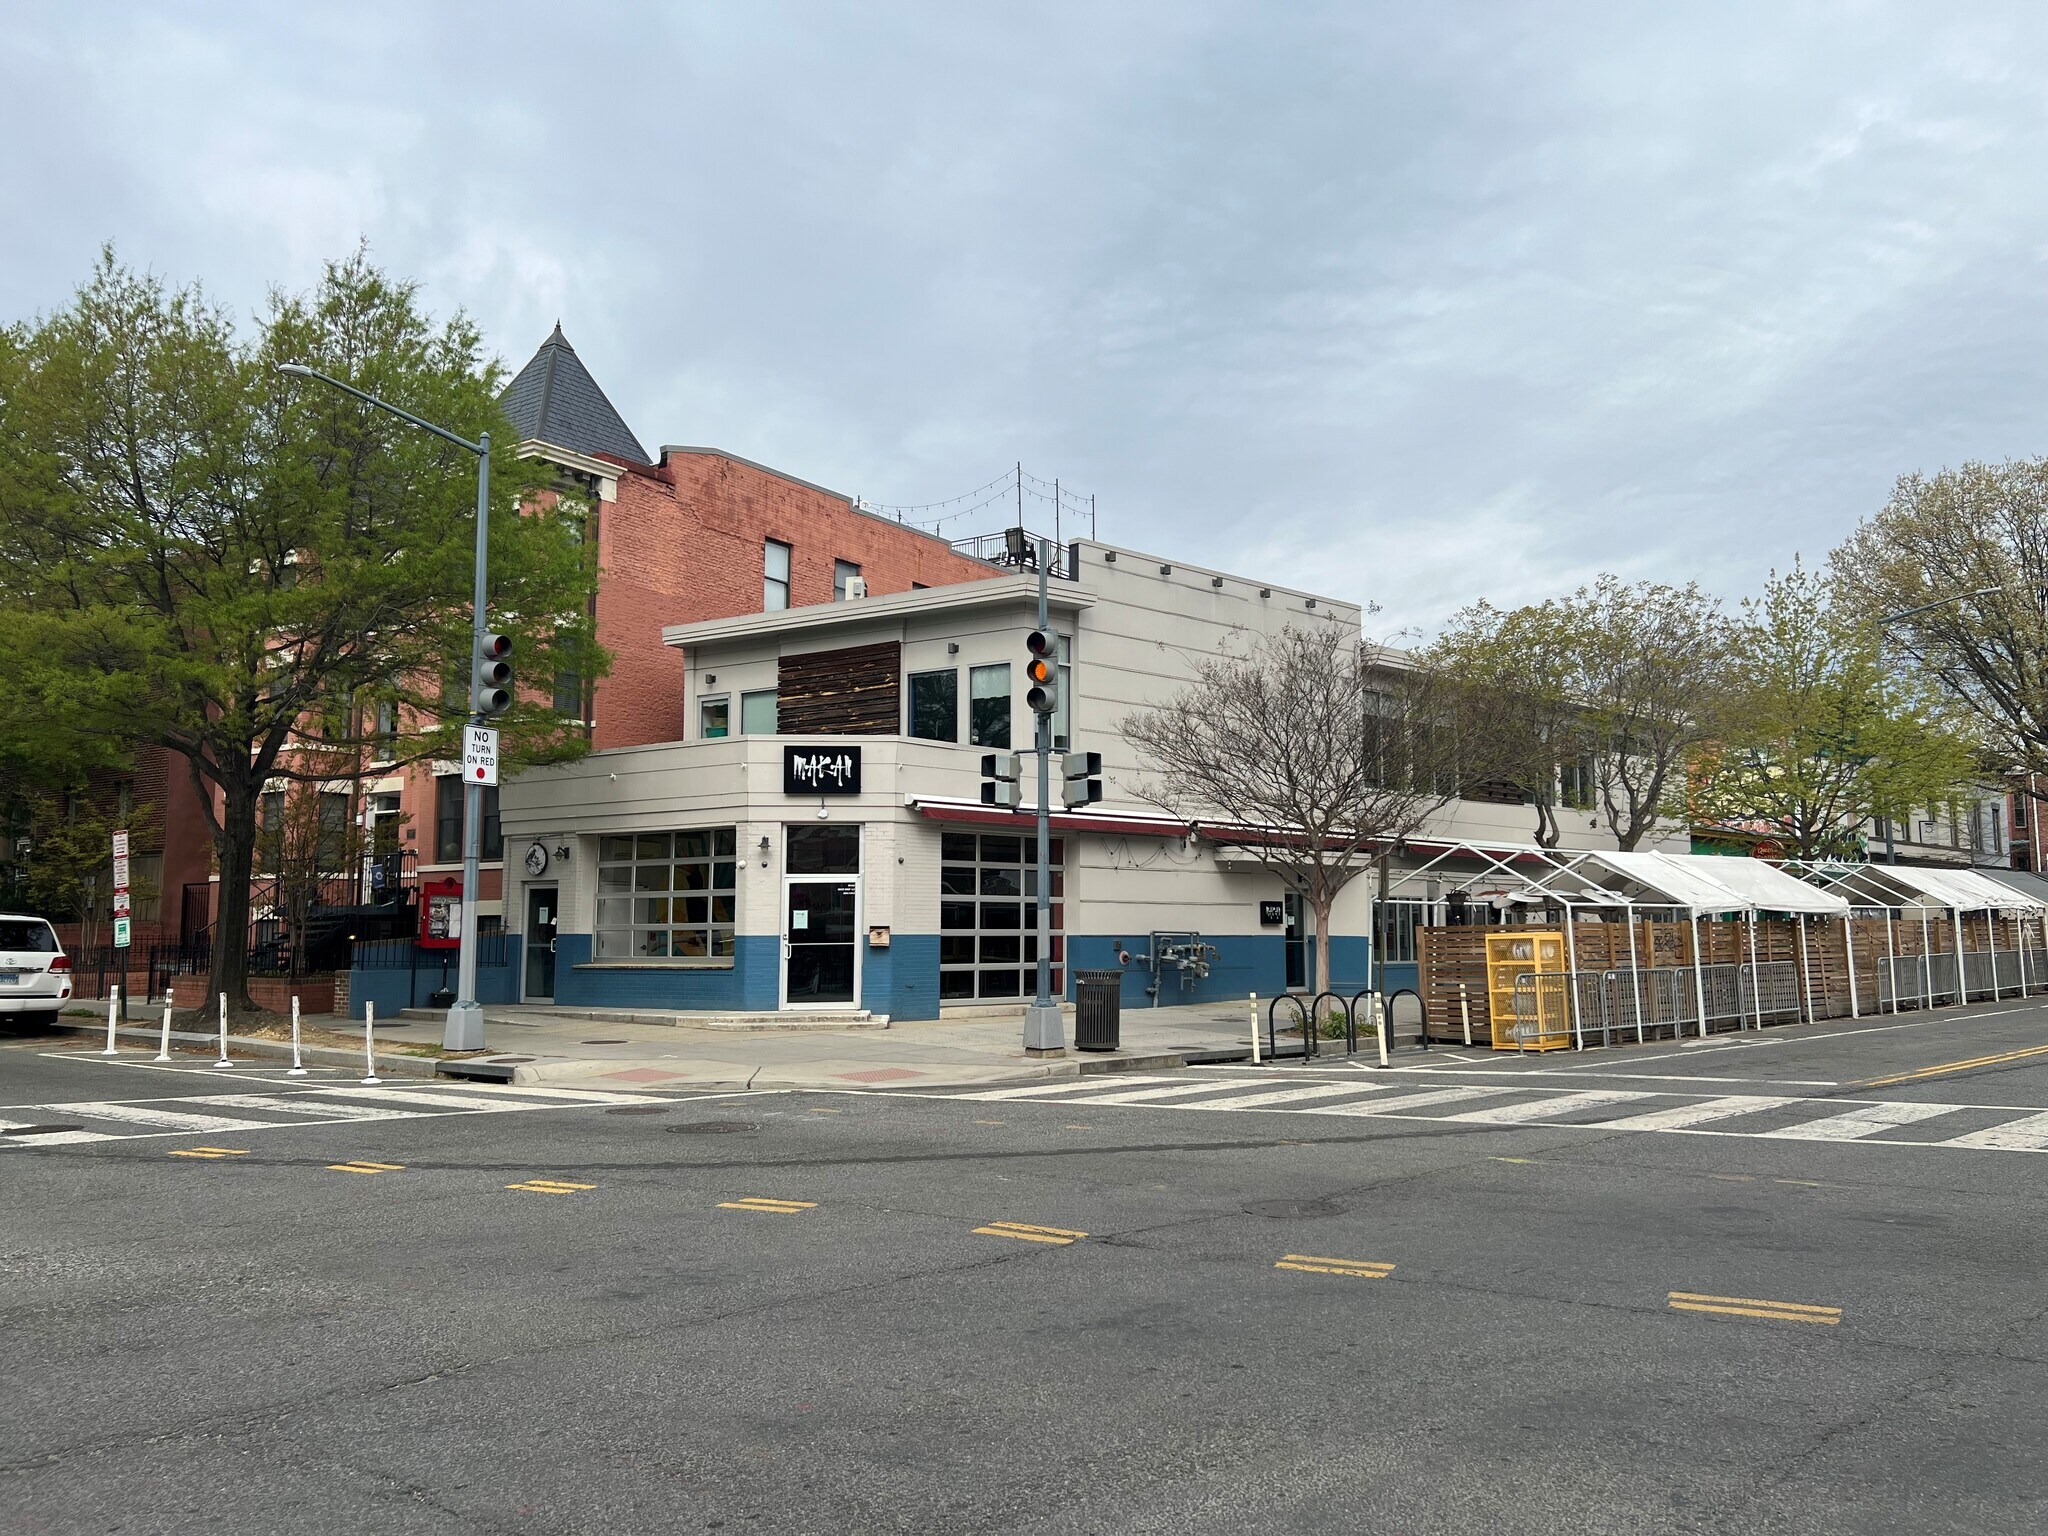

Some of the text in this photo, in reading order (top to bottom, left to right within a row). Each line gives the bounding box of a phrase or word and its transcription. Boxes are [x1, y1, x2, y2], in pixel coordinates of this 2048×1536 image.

[474, 730, 488, 742] NO
[472, 744, 490, 754] TURN
[467, 755, 494, 766] ON RED
